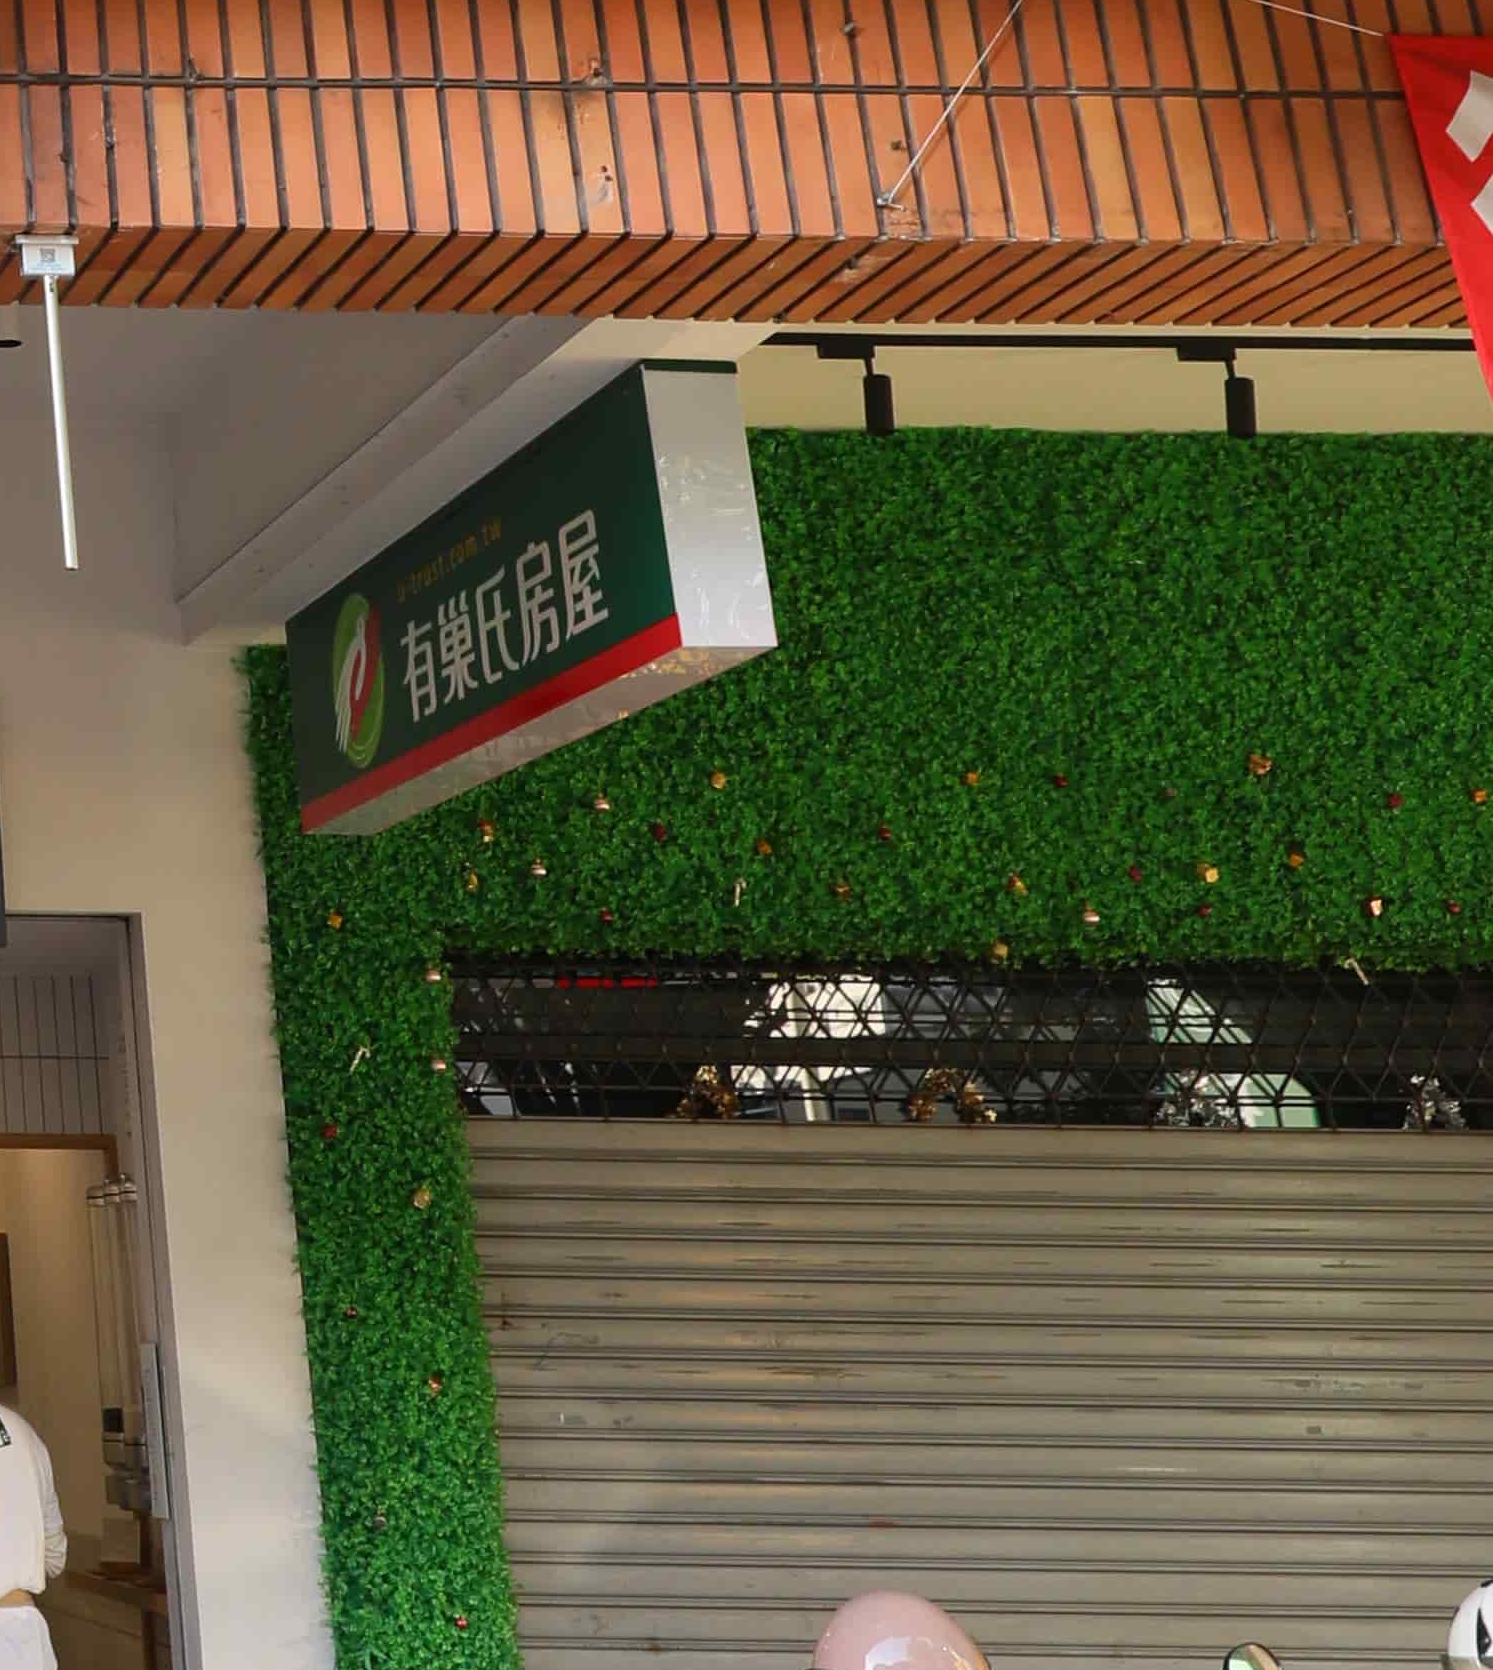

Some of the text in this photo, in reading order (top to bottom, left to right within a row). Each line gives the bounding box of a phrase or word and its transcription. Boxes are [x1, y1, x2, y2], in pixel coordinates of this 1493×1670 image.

[399, 509, 610, 723] 有巢氏房屋
